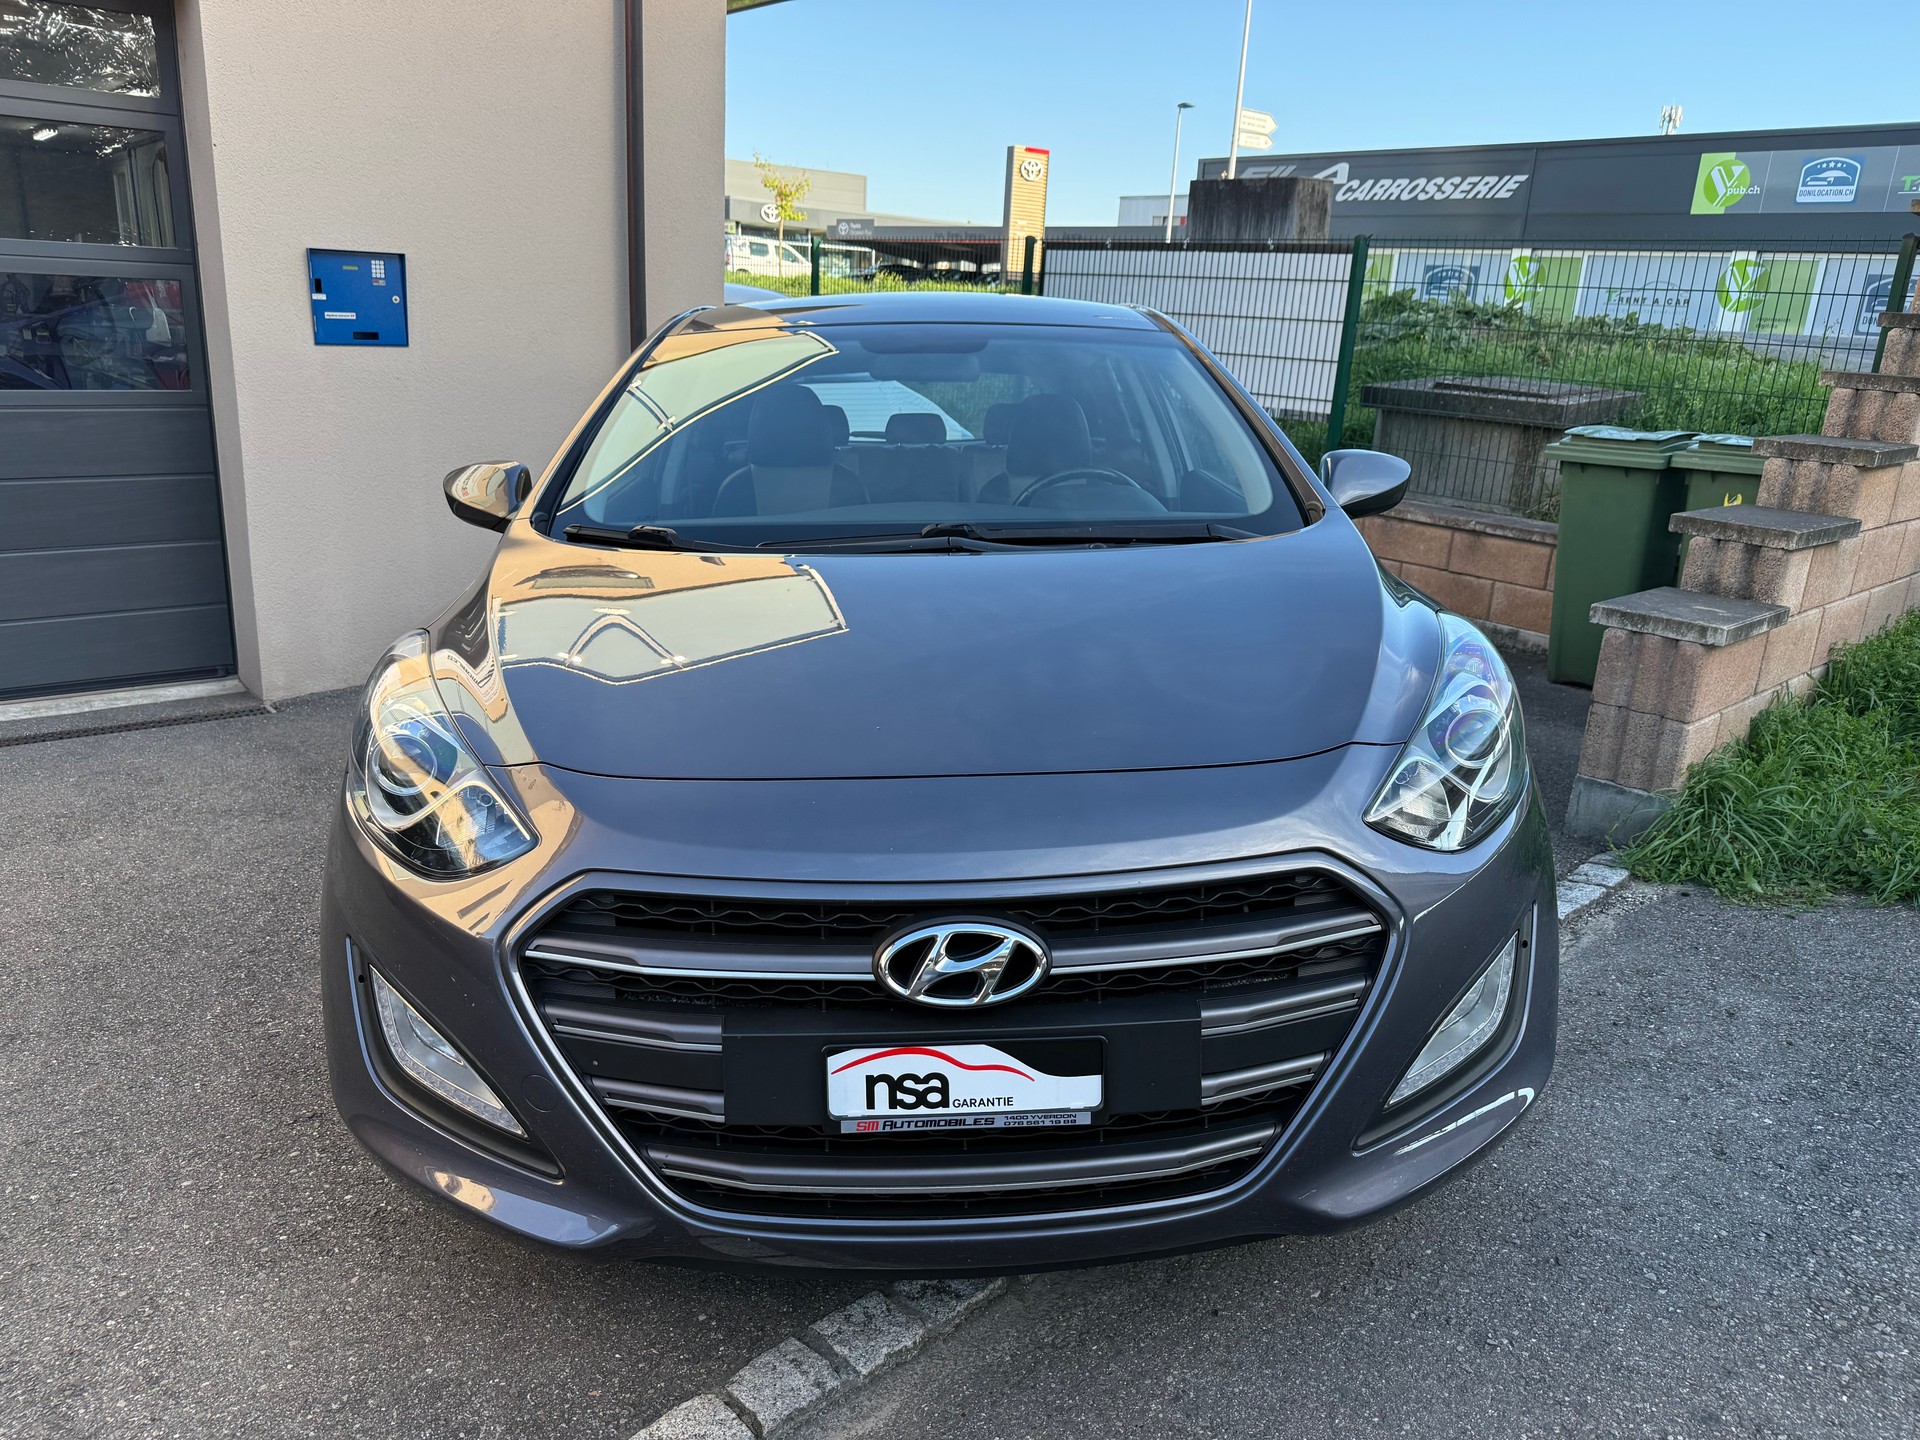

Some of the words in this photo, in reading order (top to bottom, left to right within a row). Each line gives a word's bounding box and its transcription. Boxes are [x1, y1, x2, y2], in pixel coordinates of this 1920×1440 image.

[1335, 174, 1529, 203] CARROSSERIE
[1798, 188, 1854, 198] DONILOCATION.CH
[865, 1072, 950, 1110] nsa
[952, 1096, 1014, 1109] GARANTIE
[882, 1117, 996, 1131] AUTOMOBILES
